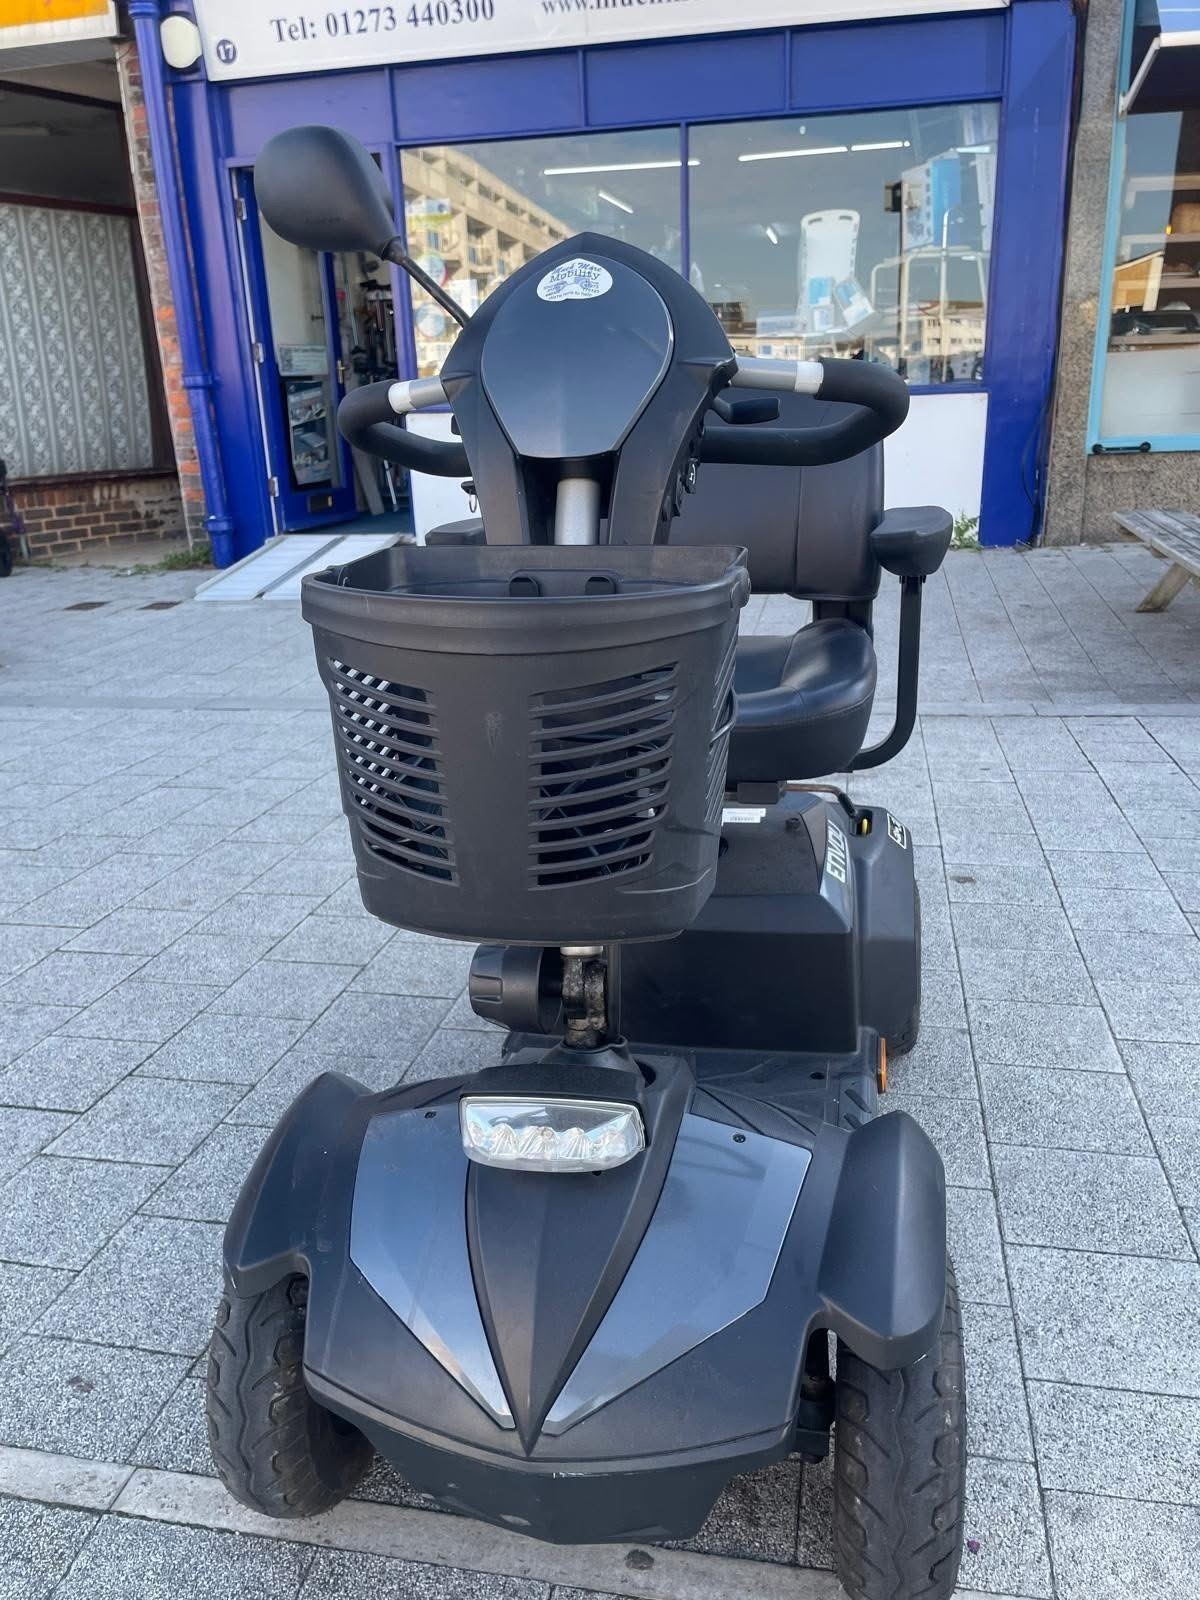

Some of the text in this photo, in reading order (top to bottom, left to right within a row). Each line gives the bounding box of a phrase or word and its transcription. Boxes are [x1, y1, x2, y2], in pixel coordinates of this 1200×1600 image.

[270, 0, 494, 42] Tel: 01273 440300
[218, 43, 235, 60] 17
[550, 269, 600, 282] Mobility
